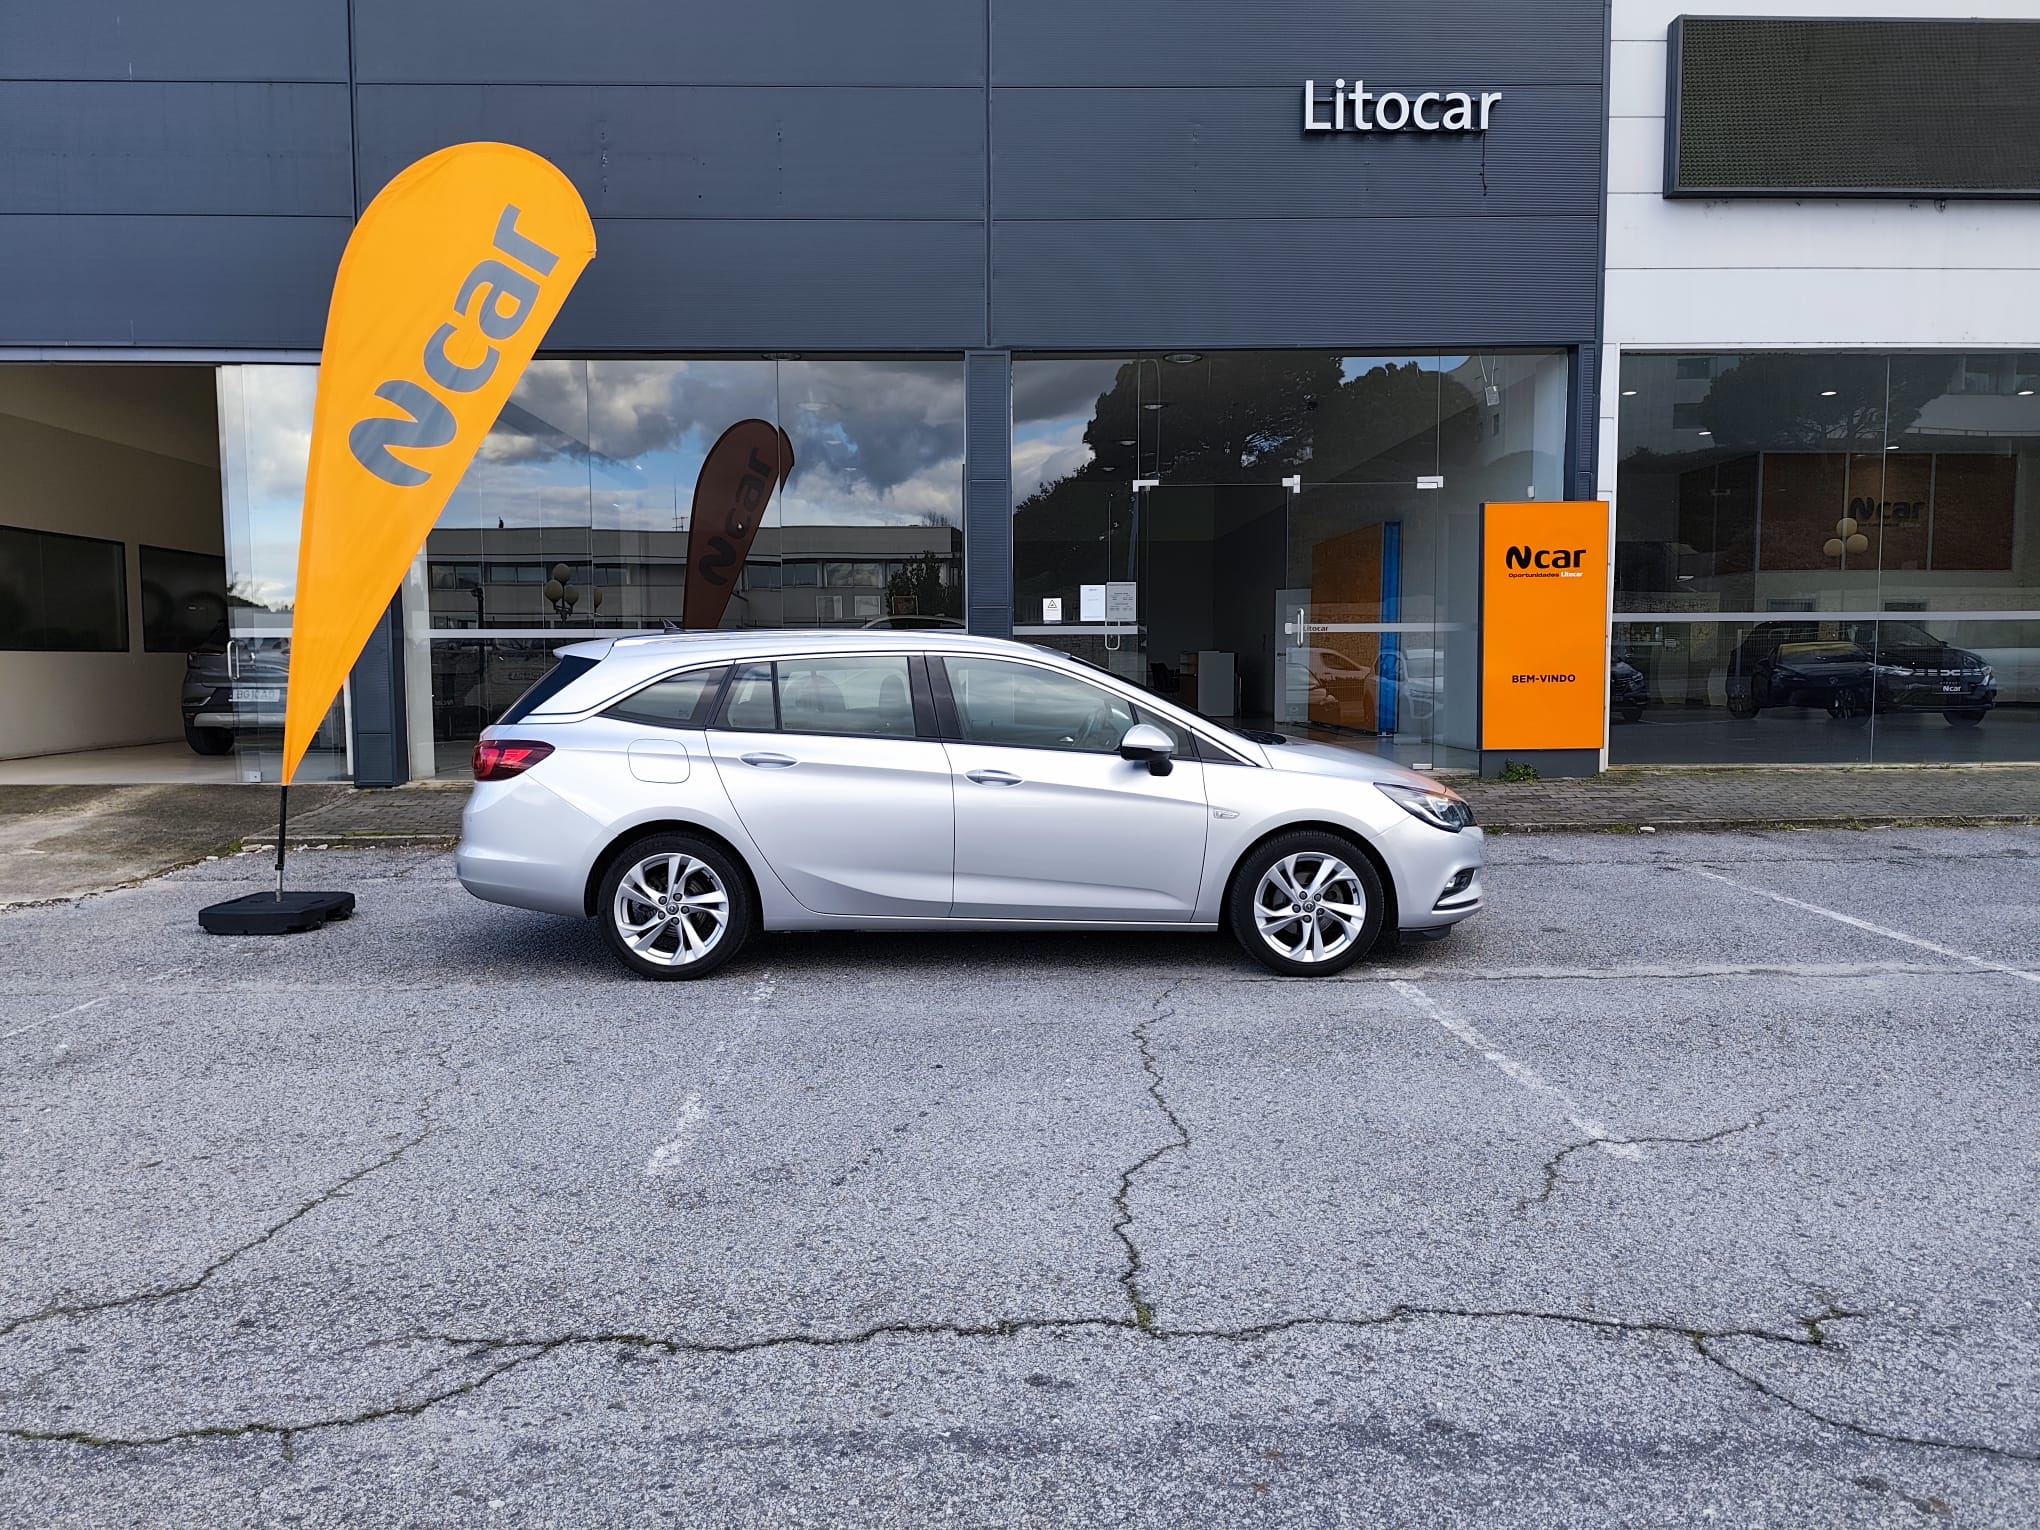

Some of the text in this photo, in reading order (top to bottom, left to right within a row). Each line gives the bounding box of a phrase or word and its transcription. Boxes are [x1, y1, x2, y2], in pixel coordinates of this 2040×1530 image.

[1304, 78, 1502, 131] Litocar
[349, 203, 561, 487] Ncar
[1506, 545, 1587, 569] Ncar
[1512, 674, 1576, 683] BEM-VINDO
